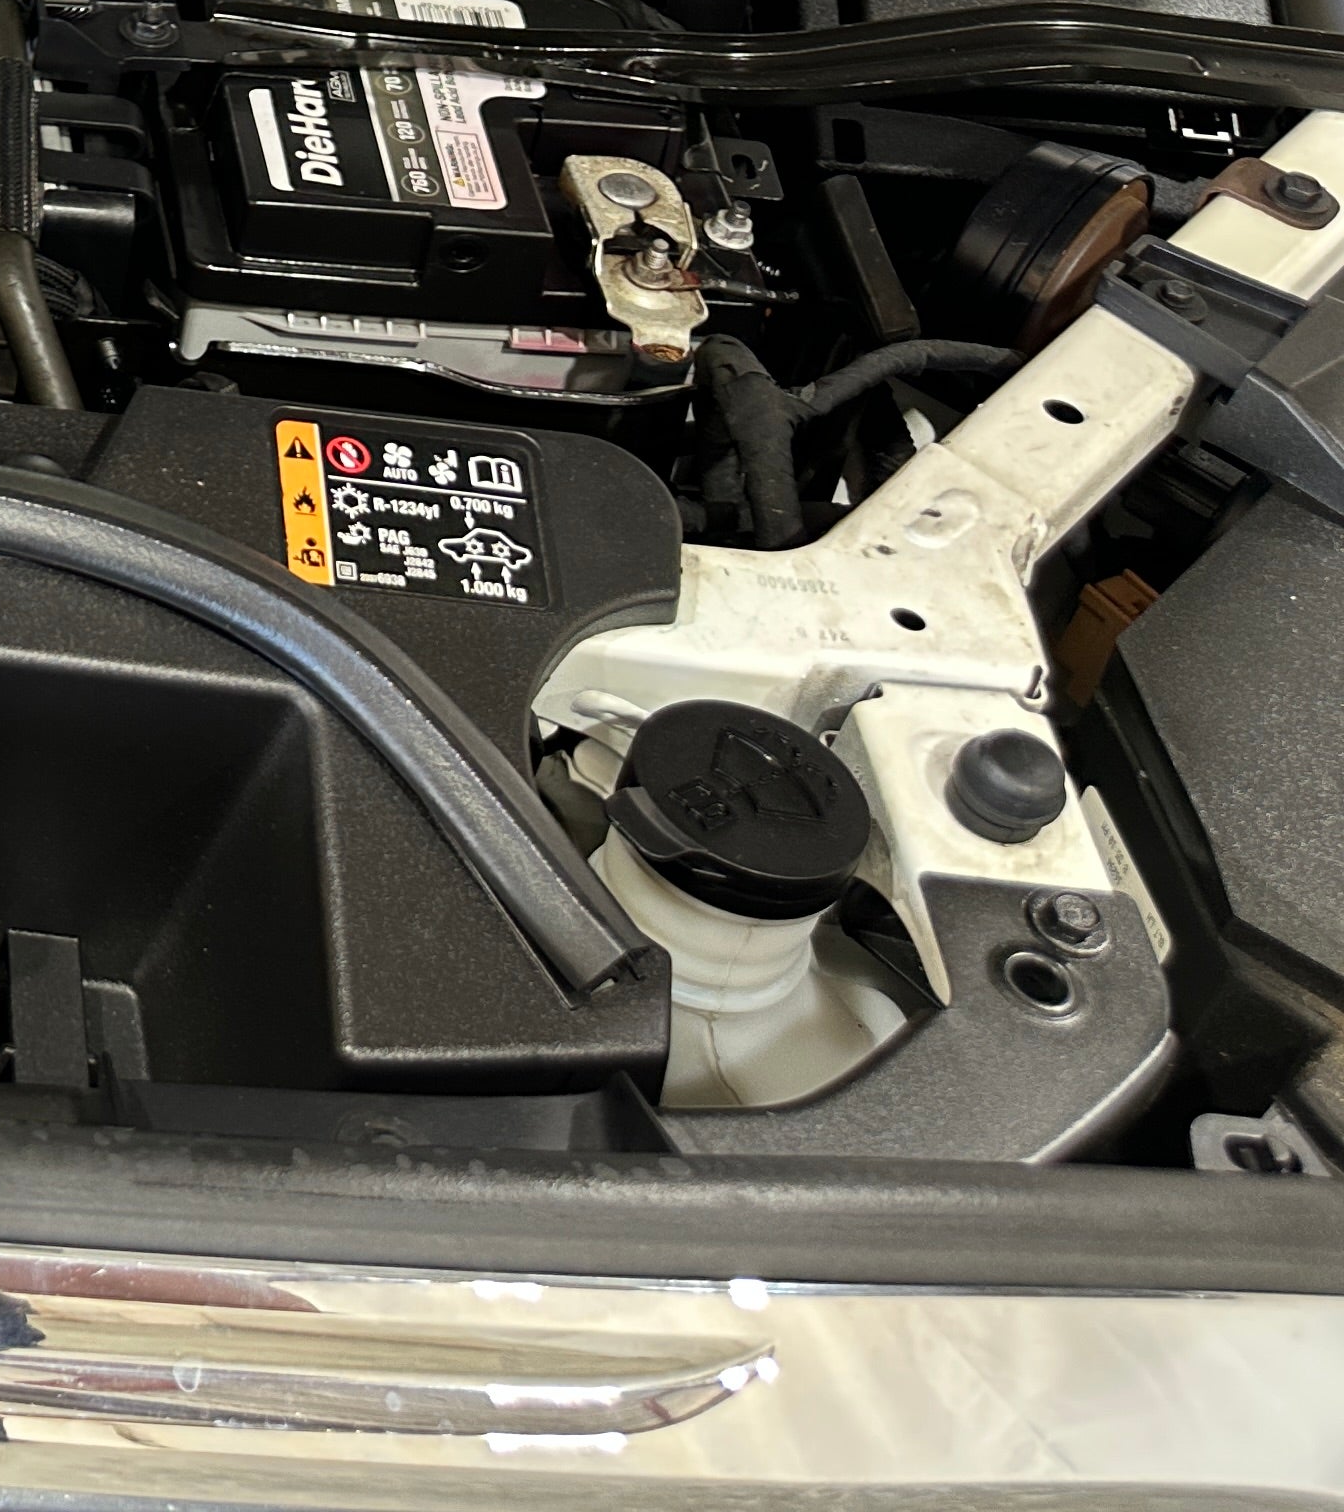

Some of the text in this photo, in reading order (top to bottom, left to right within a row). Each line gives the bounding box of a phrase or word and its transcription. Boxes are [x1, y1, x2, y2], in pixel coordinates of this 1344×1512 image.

[396, 121, 416, 142] 120
[383, 466, 419, 482] AUTO
[450, 496, 515, 520] 0.700 kg
[378, 527, 411, 546] PAG
[460, 579, 528, 603] 1.000 kg
